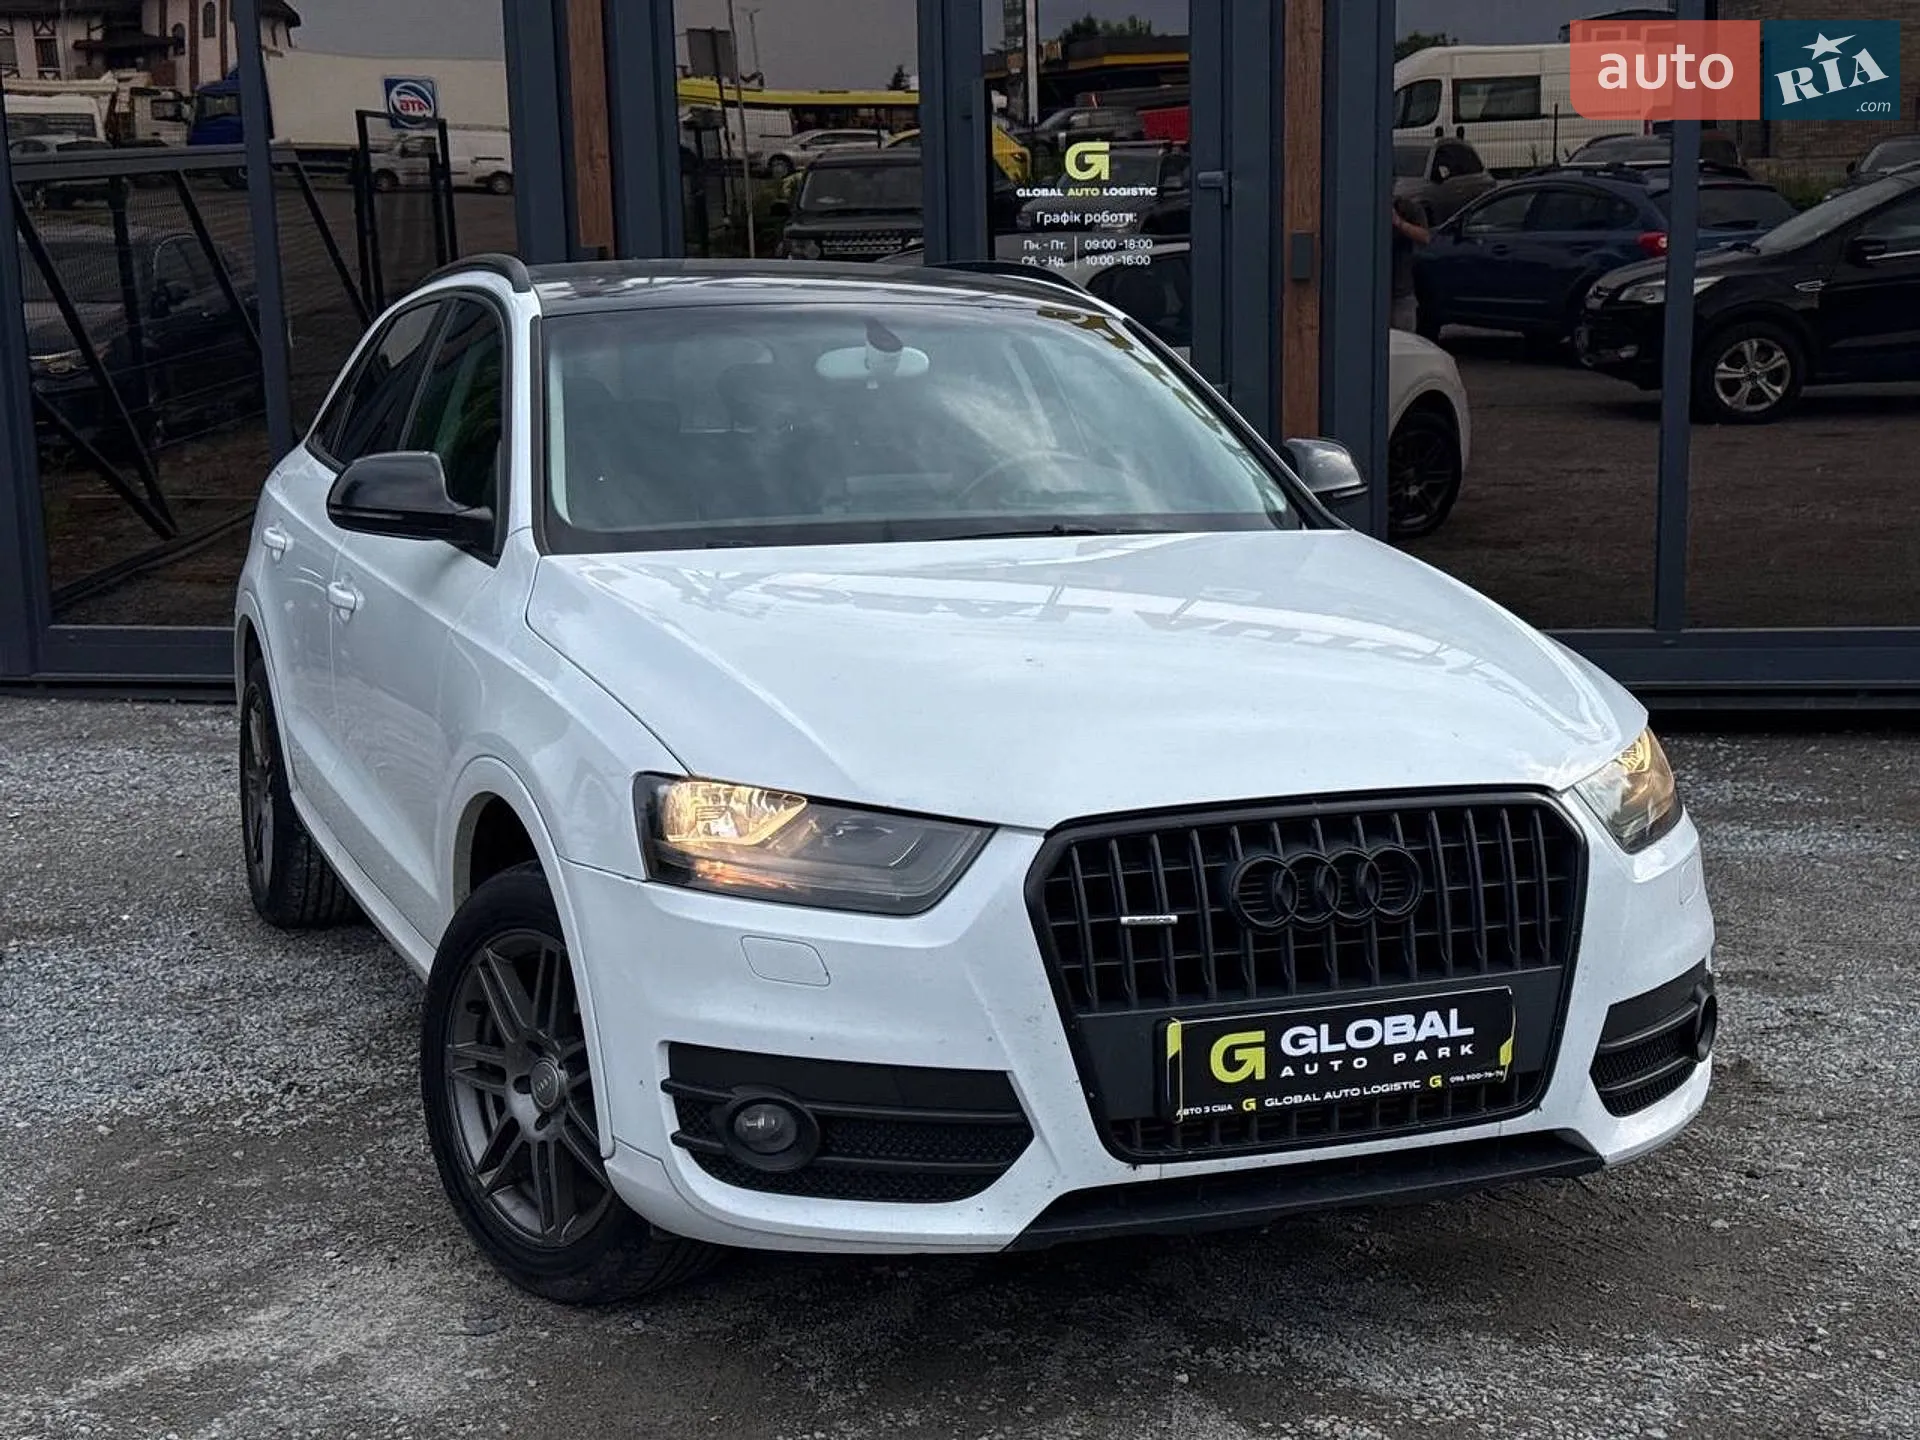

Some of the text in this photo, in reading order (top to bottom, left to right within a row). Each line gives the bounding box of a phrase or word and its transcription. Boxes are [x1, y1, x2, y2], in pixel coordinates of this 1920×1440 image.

[1016, 187, 1158, 198] GLOBAL AUTO LOGISTIC
[1036, 211, 1081, 226] Графік
[1084, 239, 1117, 250] 09:00
[1280, 1008, 1475, 1057] GLOBAL
[1280, 1043, 1475, 1078] AUTO PARK
[1264, 1092, 1322, 1107] GLOBAL
[1323, 1086, 1361, 1100] AUTO
[1363, 1080, 1422, 1095] LOGISTIC
